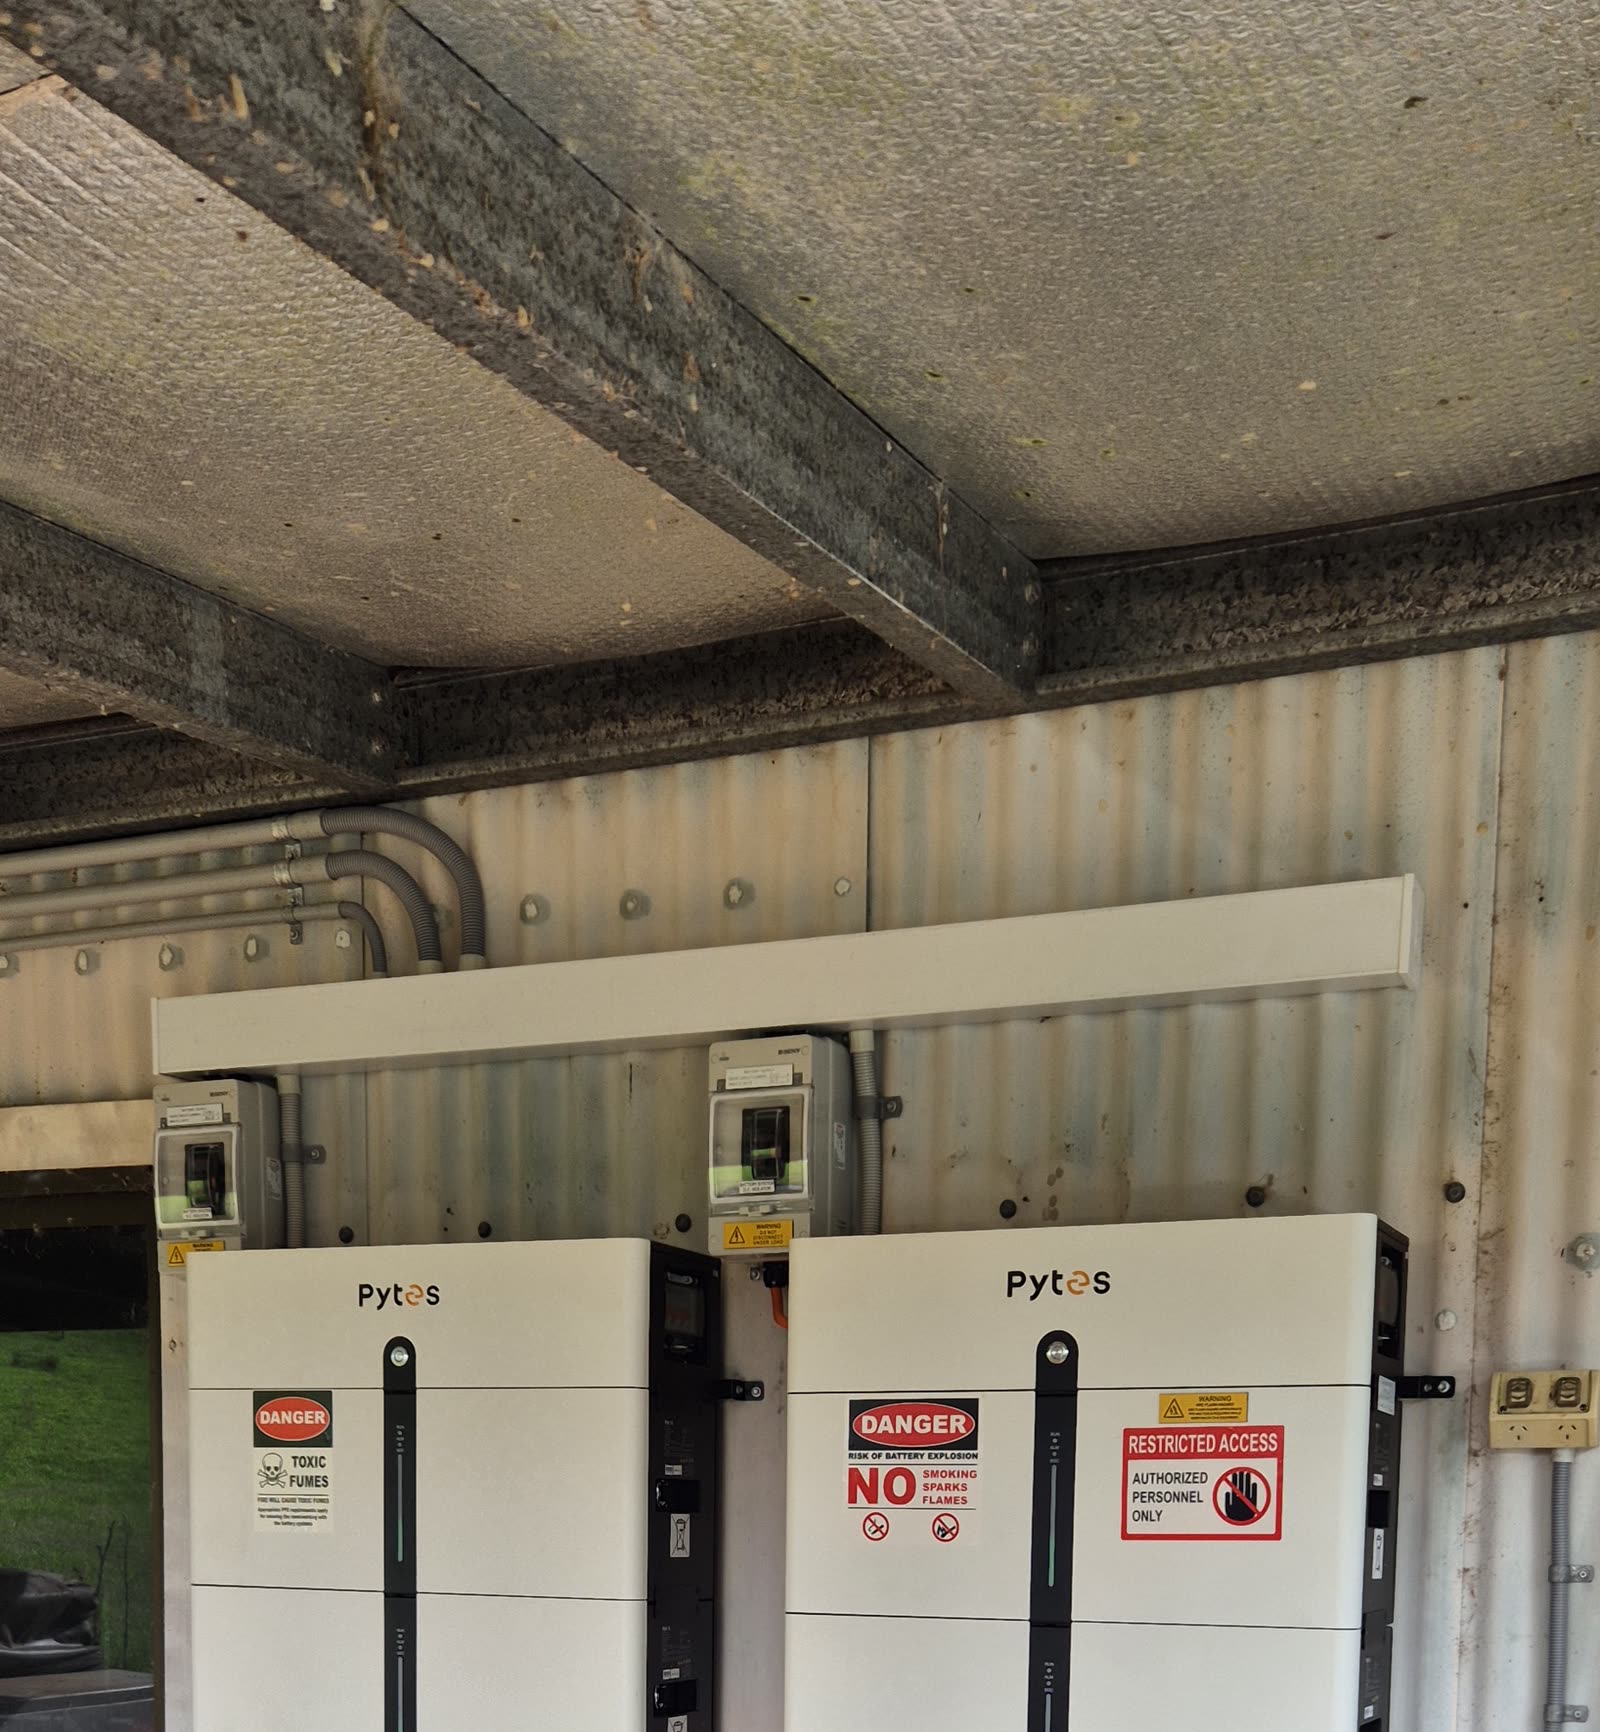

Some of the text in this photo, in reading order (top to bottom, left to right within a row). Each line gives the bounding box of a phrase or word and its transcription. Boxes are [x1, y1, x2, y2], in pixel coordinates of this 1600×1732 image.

[260, 1411, 327, 1425] DANGER
[861, 1414, 967, 1434] DANGER
[1128, 1433, 1278, 1454] RESTRICTED ACCESS
[292, 1455, 327, 1468] TOXIC
[885, 1452, 925, 1460] BATTERY
[928, 1452, 978, 1460] EXPLOSION
[922, 1470, 977, 1479] SMOKING
[1132, 1472, 1208, 1484] AUTHORIZED
[289, 1475, 329, 1488] FUMES
[848, 1467, 916, 1505] NO
[922, 1483, 968, 1492] SPARKS
[922, 1496, 968, 1504] FLAMES
[1132, 1491, 1203, 1503] PERSONNEL
[1132, 1510, 1163, 1522] ONLY
